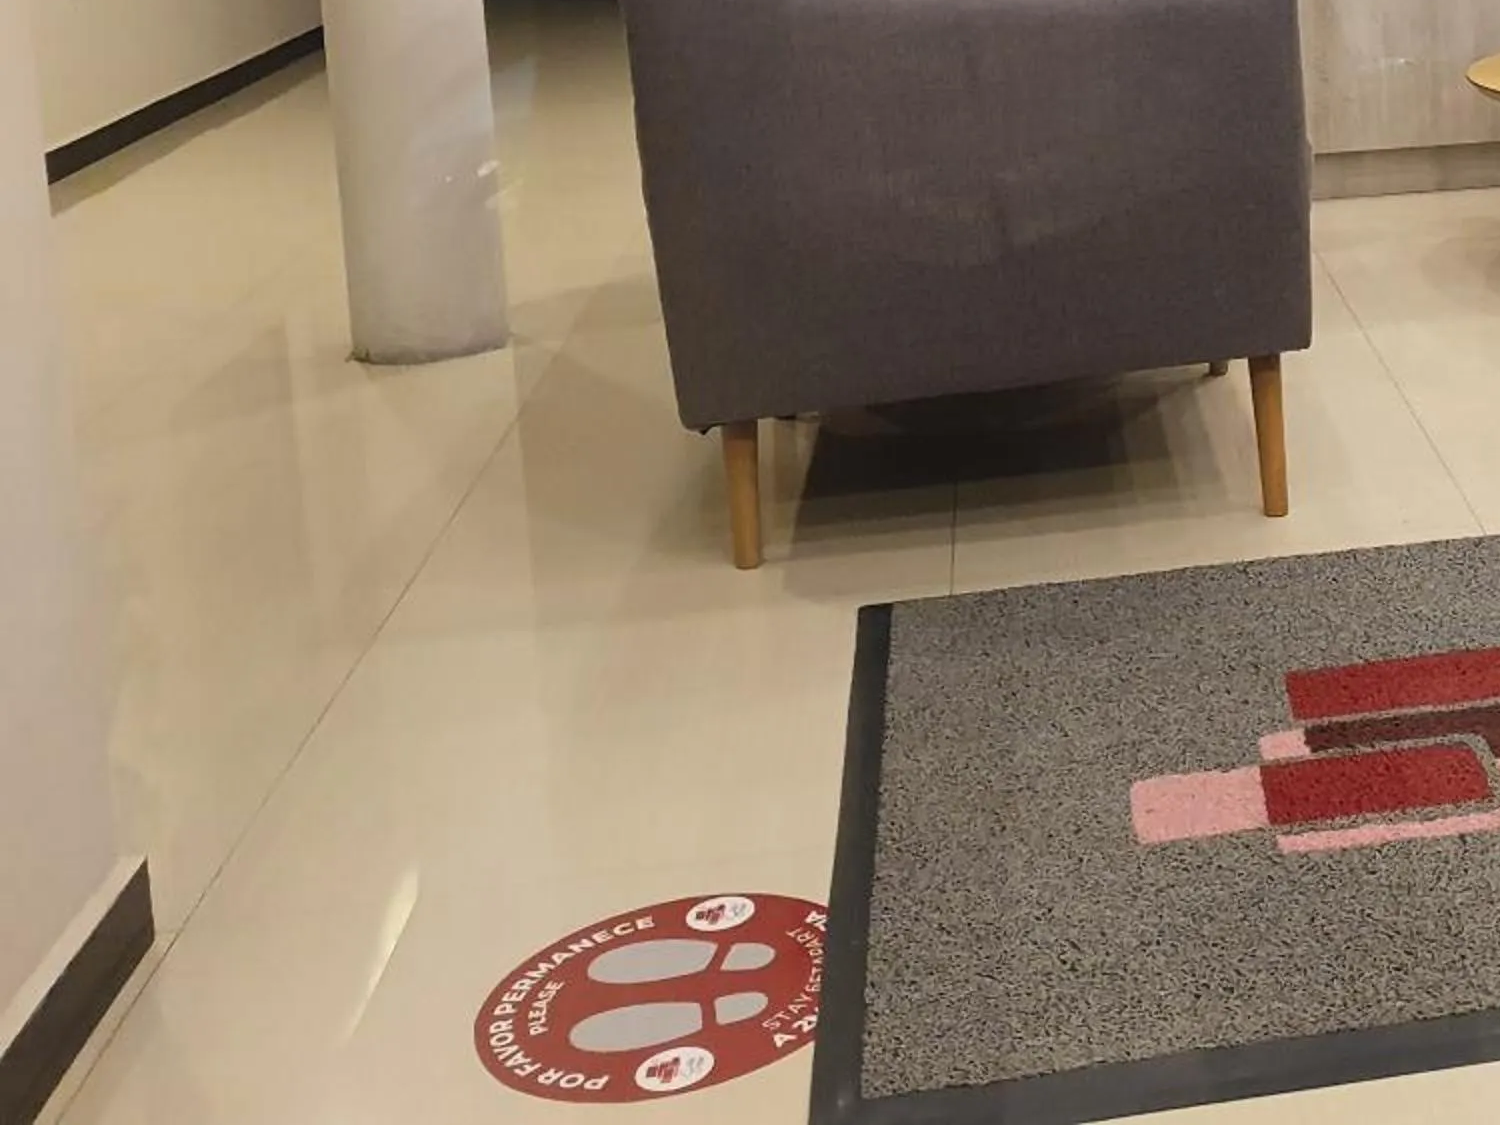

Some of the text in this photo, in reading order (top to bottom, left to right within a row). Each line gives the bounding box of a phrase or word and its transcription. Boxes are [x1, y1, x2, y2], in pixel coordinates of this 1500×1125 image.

[488, 915, 656, 1091] POR FAVOR PERMANECE
[527, 980, 565, 1036] PLEASE
[761, 992, 813, 1031] STAY
